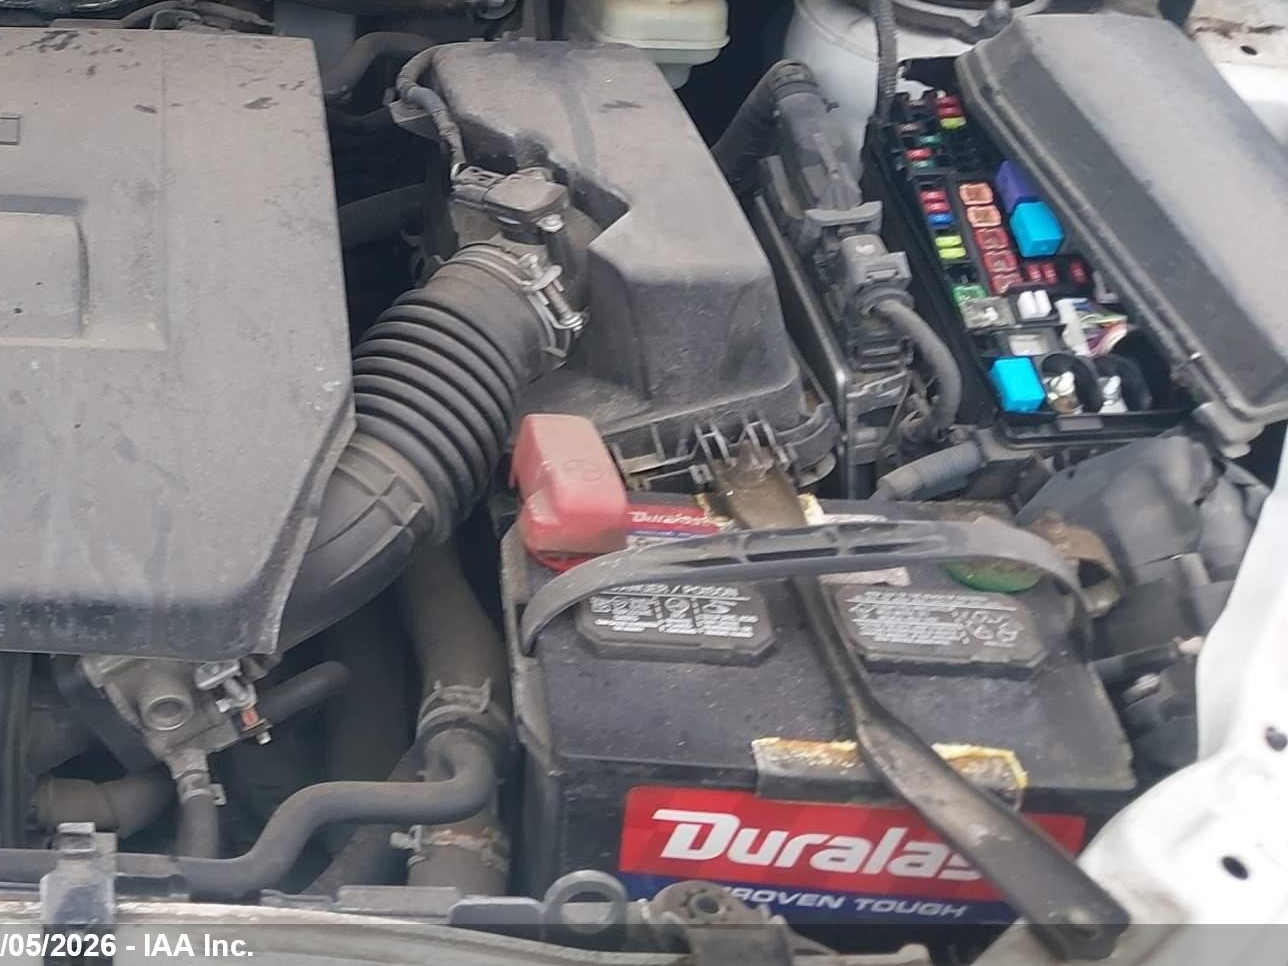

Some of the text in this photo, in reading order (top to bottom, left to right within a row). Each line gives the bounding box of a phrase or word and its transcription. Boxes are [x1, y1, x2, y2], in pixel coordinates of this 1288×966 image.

[652, 808, 982, 882] Duralas
[722, 885, 968, 918] ROVEN TOUGH
